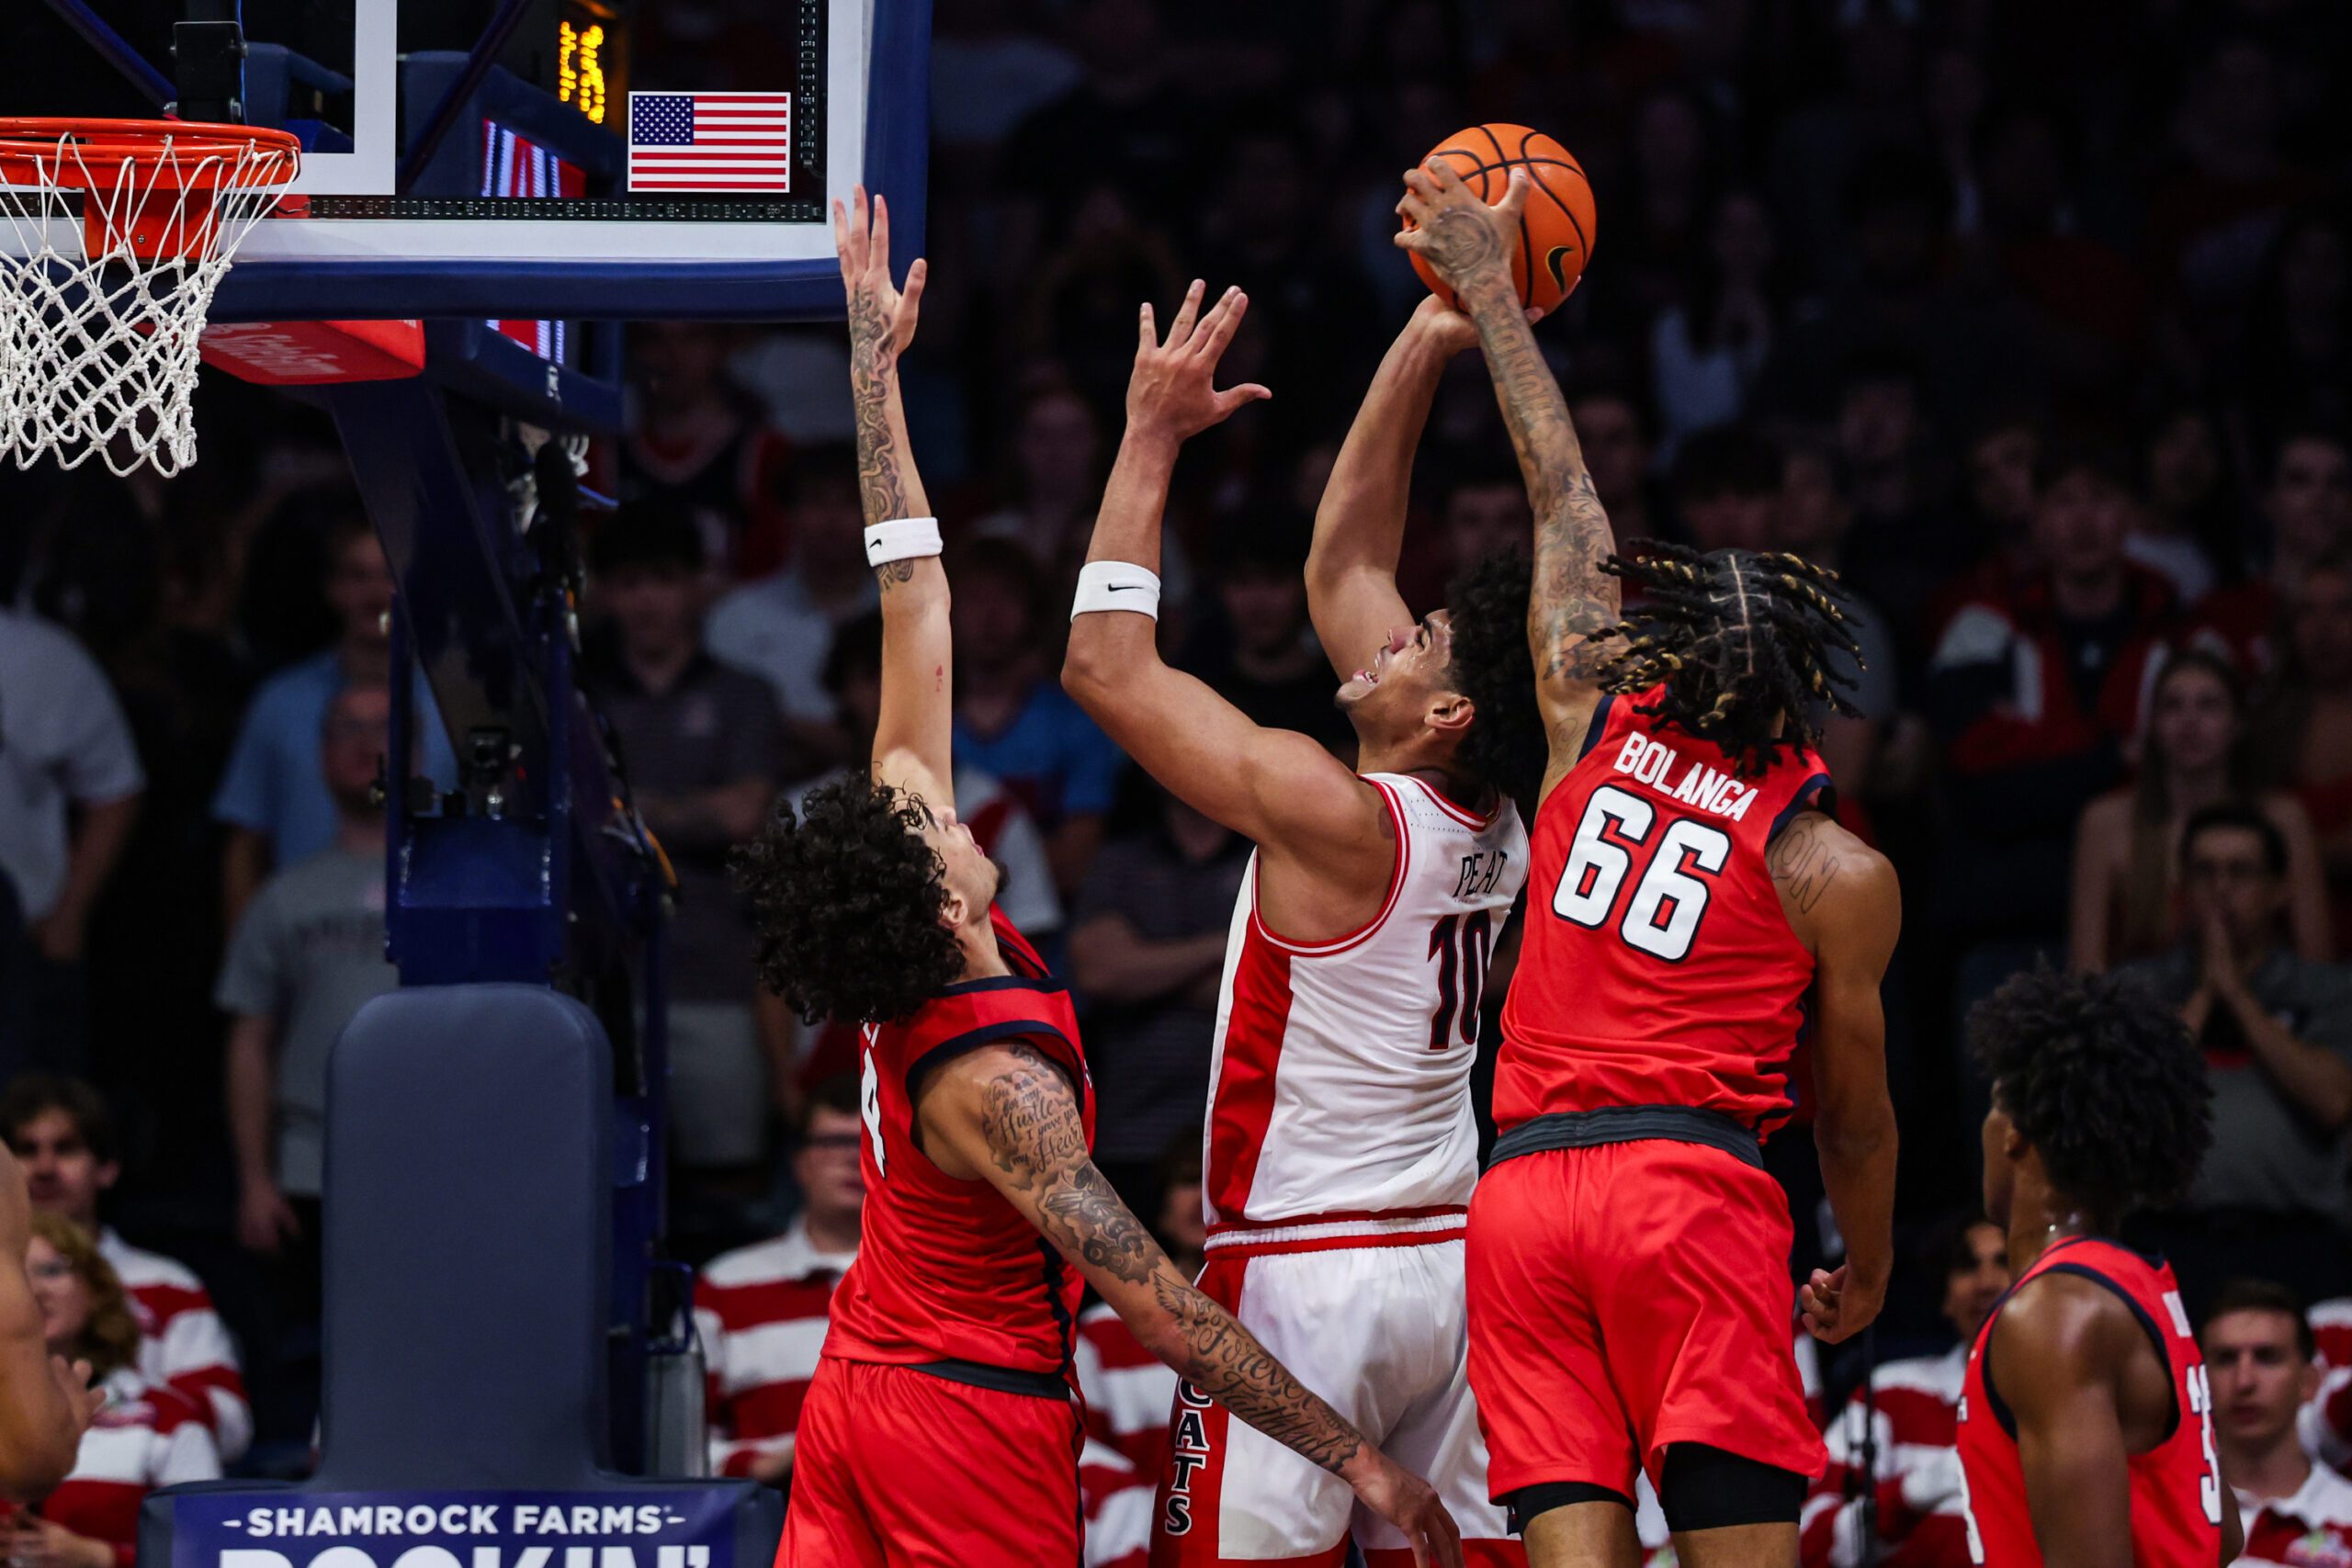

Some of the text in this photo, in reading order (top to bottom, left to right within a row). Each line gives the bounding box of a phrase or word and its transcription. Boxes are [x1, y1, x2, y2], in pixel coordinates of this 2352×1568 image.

[1613, 731, 1759, 822] BOLANGA
[1452, 850, 1508, 897] PEAT
[1553, 784, 1732, 964] 66
[1427, 908, 1490, 1050] 10
[246, 1505, 662, 1537] SHAMROCK FARMS
